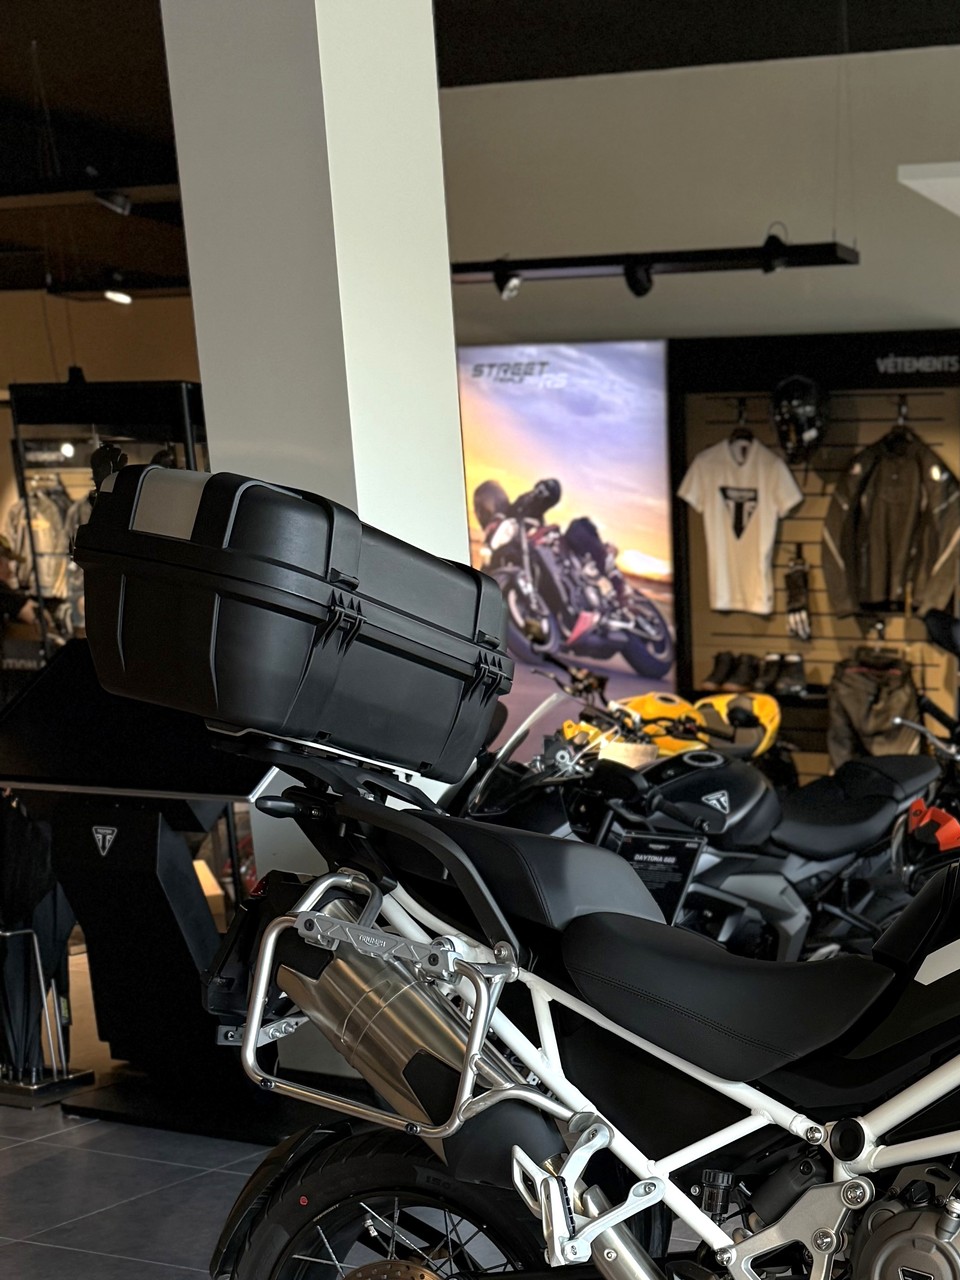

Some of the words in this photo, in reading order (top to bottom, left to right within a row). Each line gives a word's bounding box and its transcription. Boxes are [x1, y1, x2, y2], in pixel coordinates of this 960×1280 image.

[472, 361, 549, 378] STREET
[876, 353, 960, 374] VÊTEMENTS
[634, 854, 663, 862] DAYTONA
